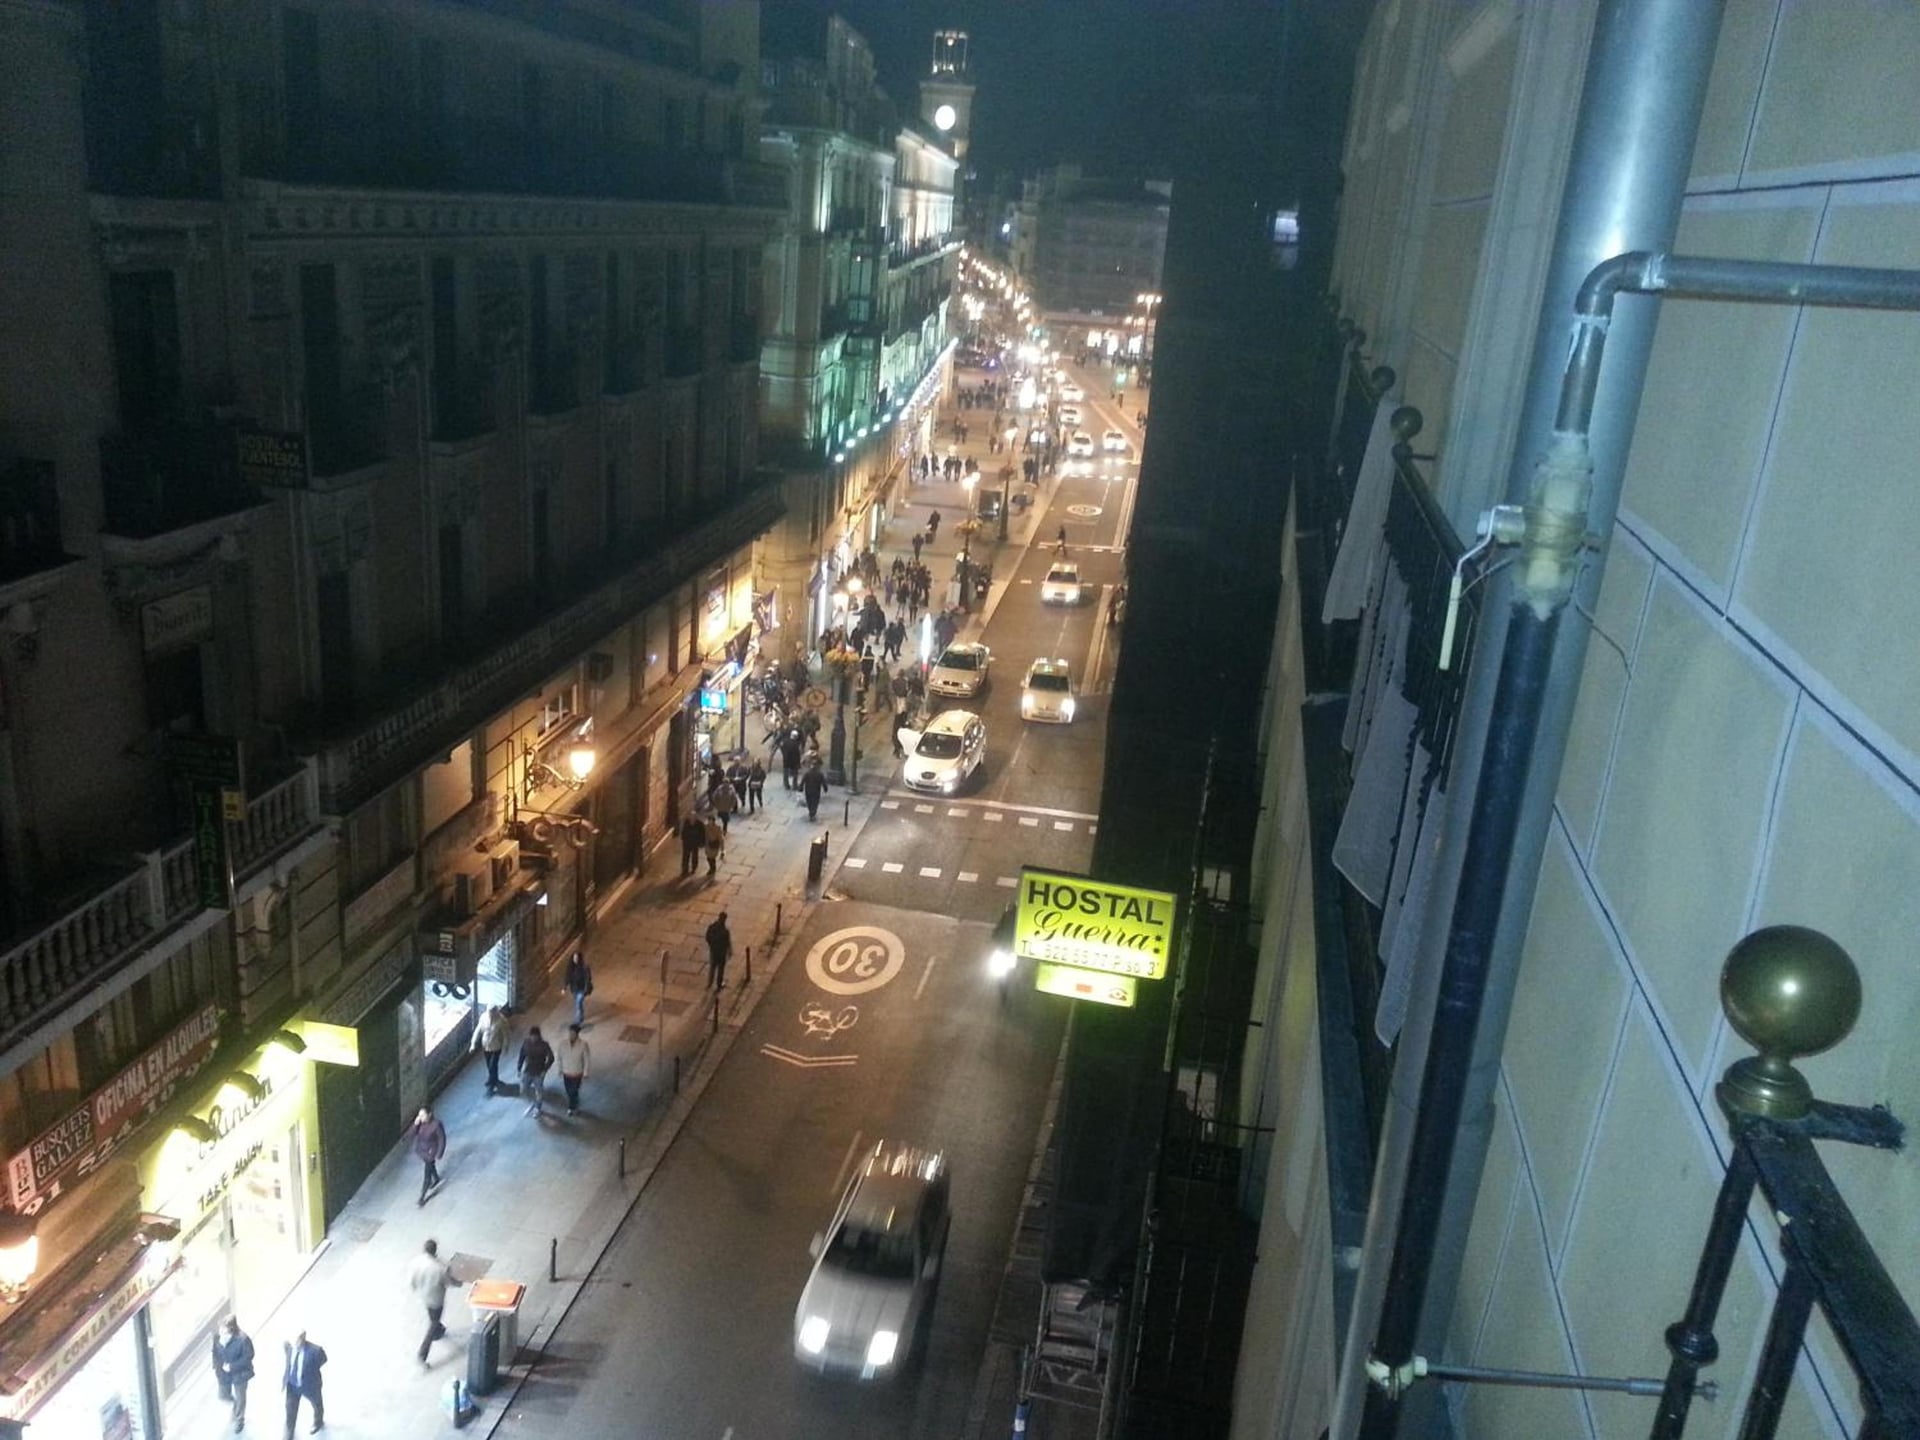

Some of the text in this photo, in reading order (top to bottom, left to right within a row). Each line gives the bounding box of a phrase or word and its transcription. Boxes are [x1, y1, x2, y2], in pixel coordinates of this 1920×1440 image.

[1027, 880, 1164, 926] HOSTAL
[829, 942, 885, 977] 30
[96, 1005, 219, 1125] OFICINA EN ALQUILER
[33, 1105, 91, 1161] BUSQUETS
[36, 1125, 92, 1179] GALVEZ
[197, 1170, 230, 1212] TAKE
[62, 1333, 91, 1364] CON
[91, 1315, 108, 1336] LA
